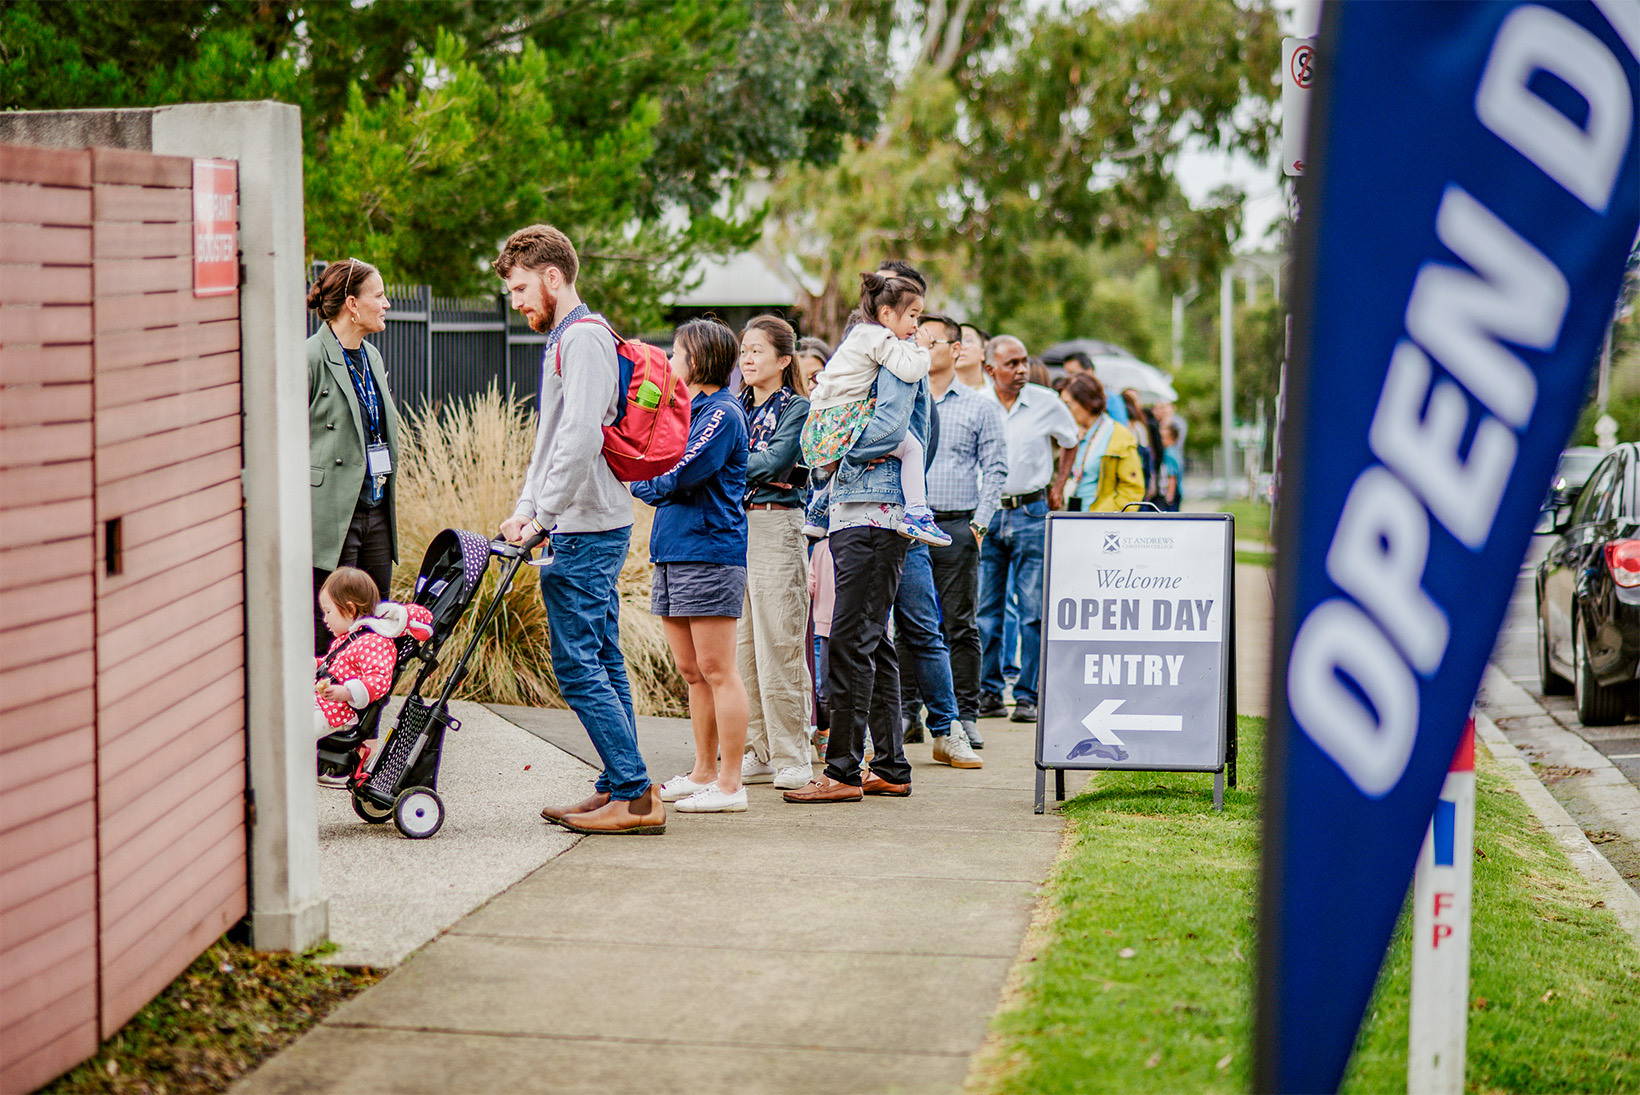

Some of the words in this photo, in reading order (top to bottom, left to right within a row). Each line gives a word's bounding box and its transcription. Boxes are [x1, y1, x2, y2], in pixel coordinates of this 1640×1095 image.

[1287, 183, 1570, 797] OPEN
[1096, 568, 1183, 589] Welcome
[1057, 598, 1140, 631] OPEN
[1151, 599, 1214, 631] DAY
[1084, 654, 1185, 686] ENTRY
